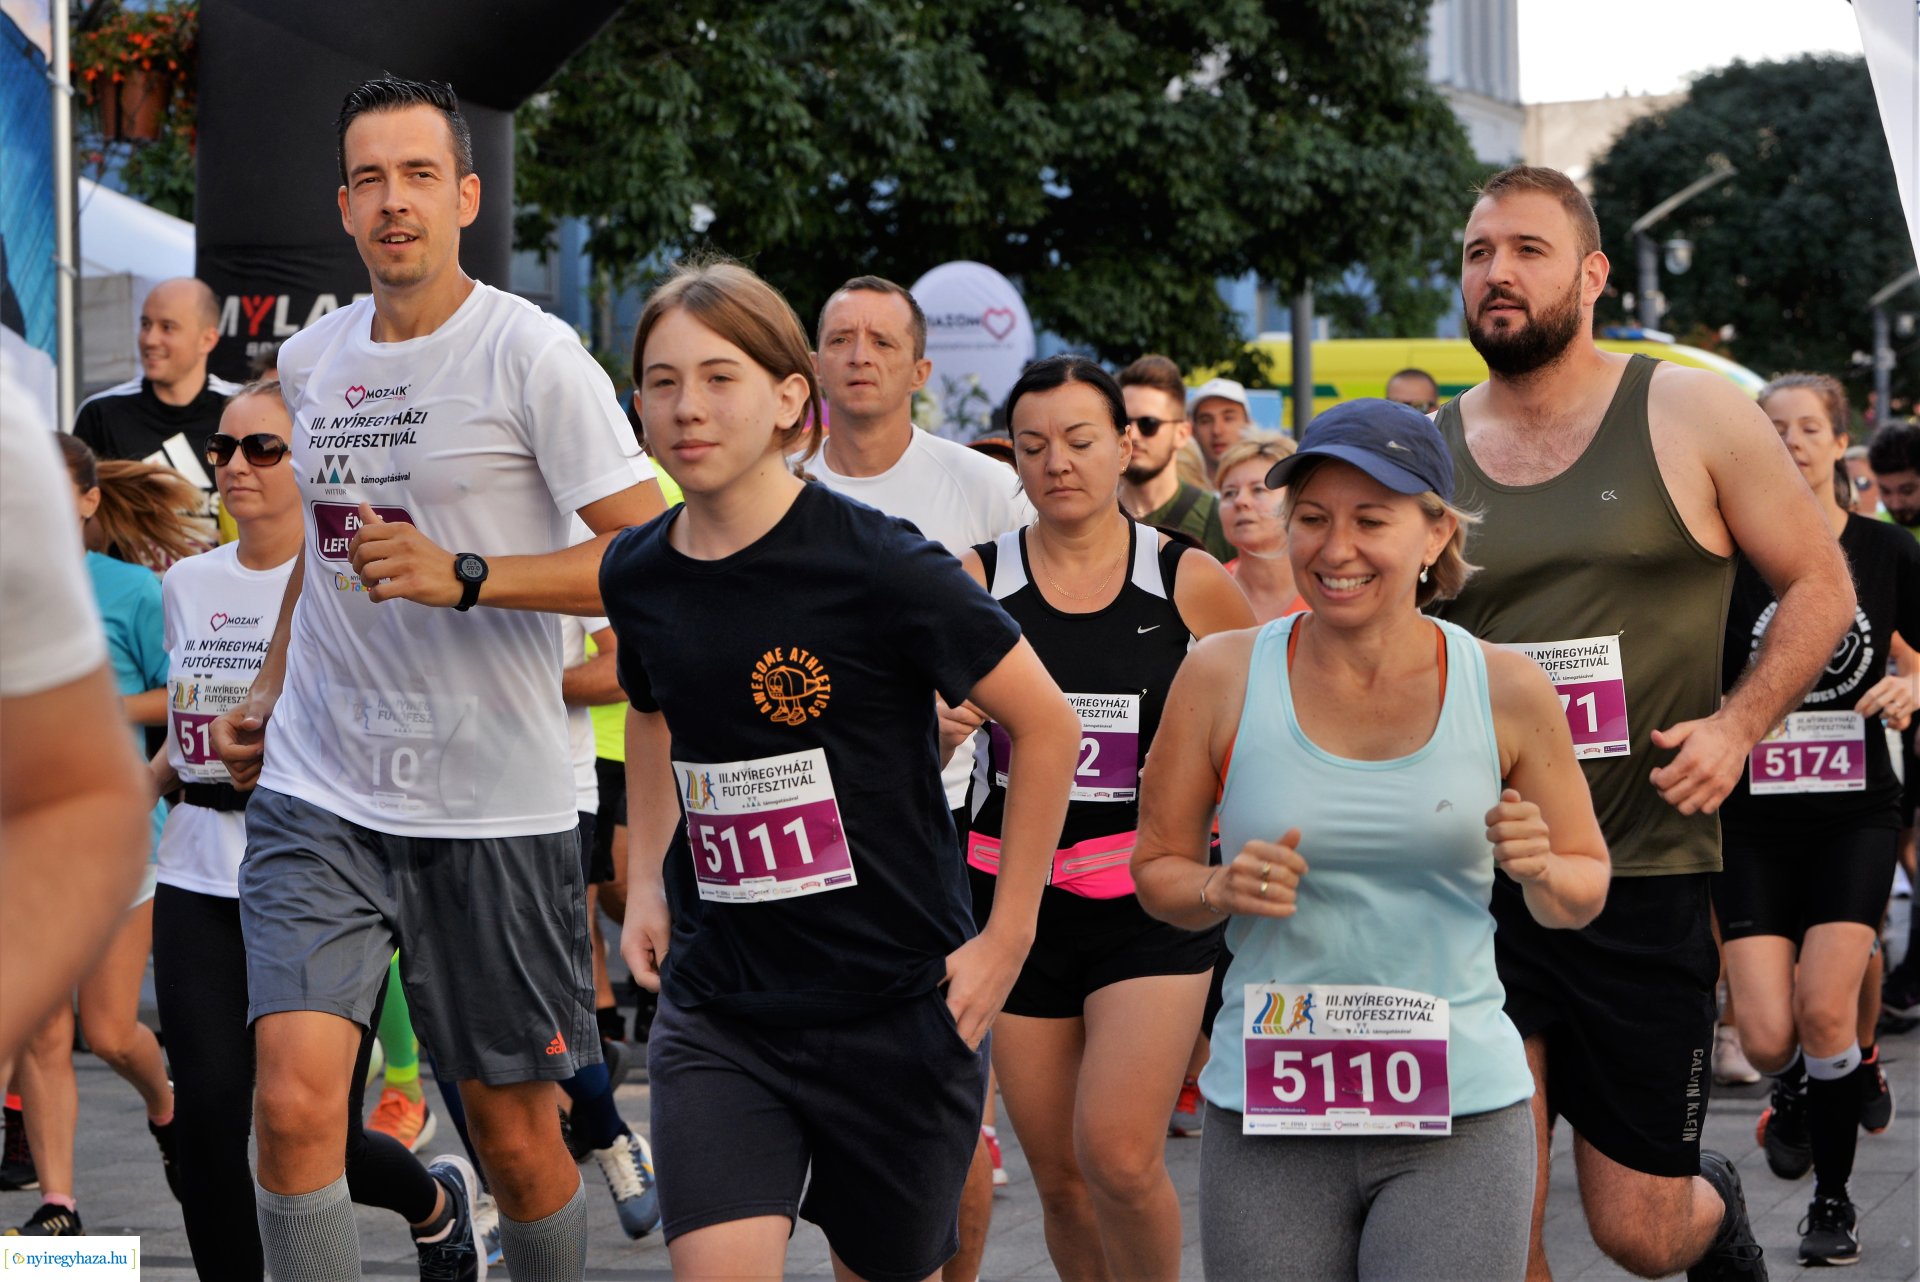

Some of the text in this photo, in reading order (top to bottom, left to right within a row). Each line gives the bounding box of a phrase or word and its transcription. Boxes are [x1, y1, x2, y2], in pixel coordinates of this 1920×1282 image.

[218, 293, 373, 337] MYLA
[366, 385, 407, 399] MOZAIK
[311, 408, 428, 430] III. NYÍREGYHÁZI
[308, 428, 417, 449] FUTÓFESZTIVÁL
[361, 472, 411, 485] támogatásával
[226, 617, 260, 625] MOZAIK
[184, 640, 196, 651] III.
[751, 647, 831, 717] AWESOME ATHLETICS
[1067, 696, 1130, 709] YÍREGYHÁZI
[181, 720, 211, 758] 51
[1076, 737, 1100, 777] 2
[1765, 745, 1851, 777] 5174
[722, 774, 816, 797] FUTÓFESZTIVÁL
[700, 816, 814, 874] 5111
[1326, 1007, 1435, 1022] FUTÓFESZTIVÁL
[1272, 1050, 1421, 1103] 5110
[1682, 1048, 1704, 1142] CALVIN KLEIN
